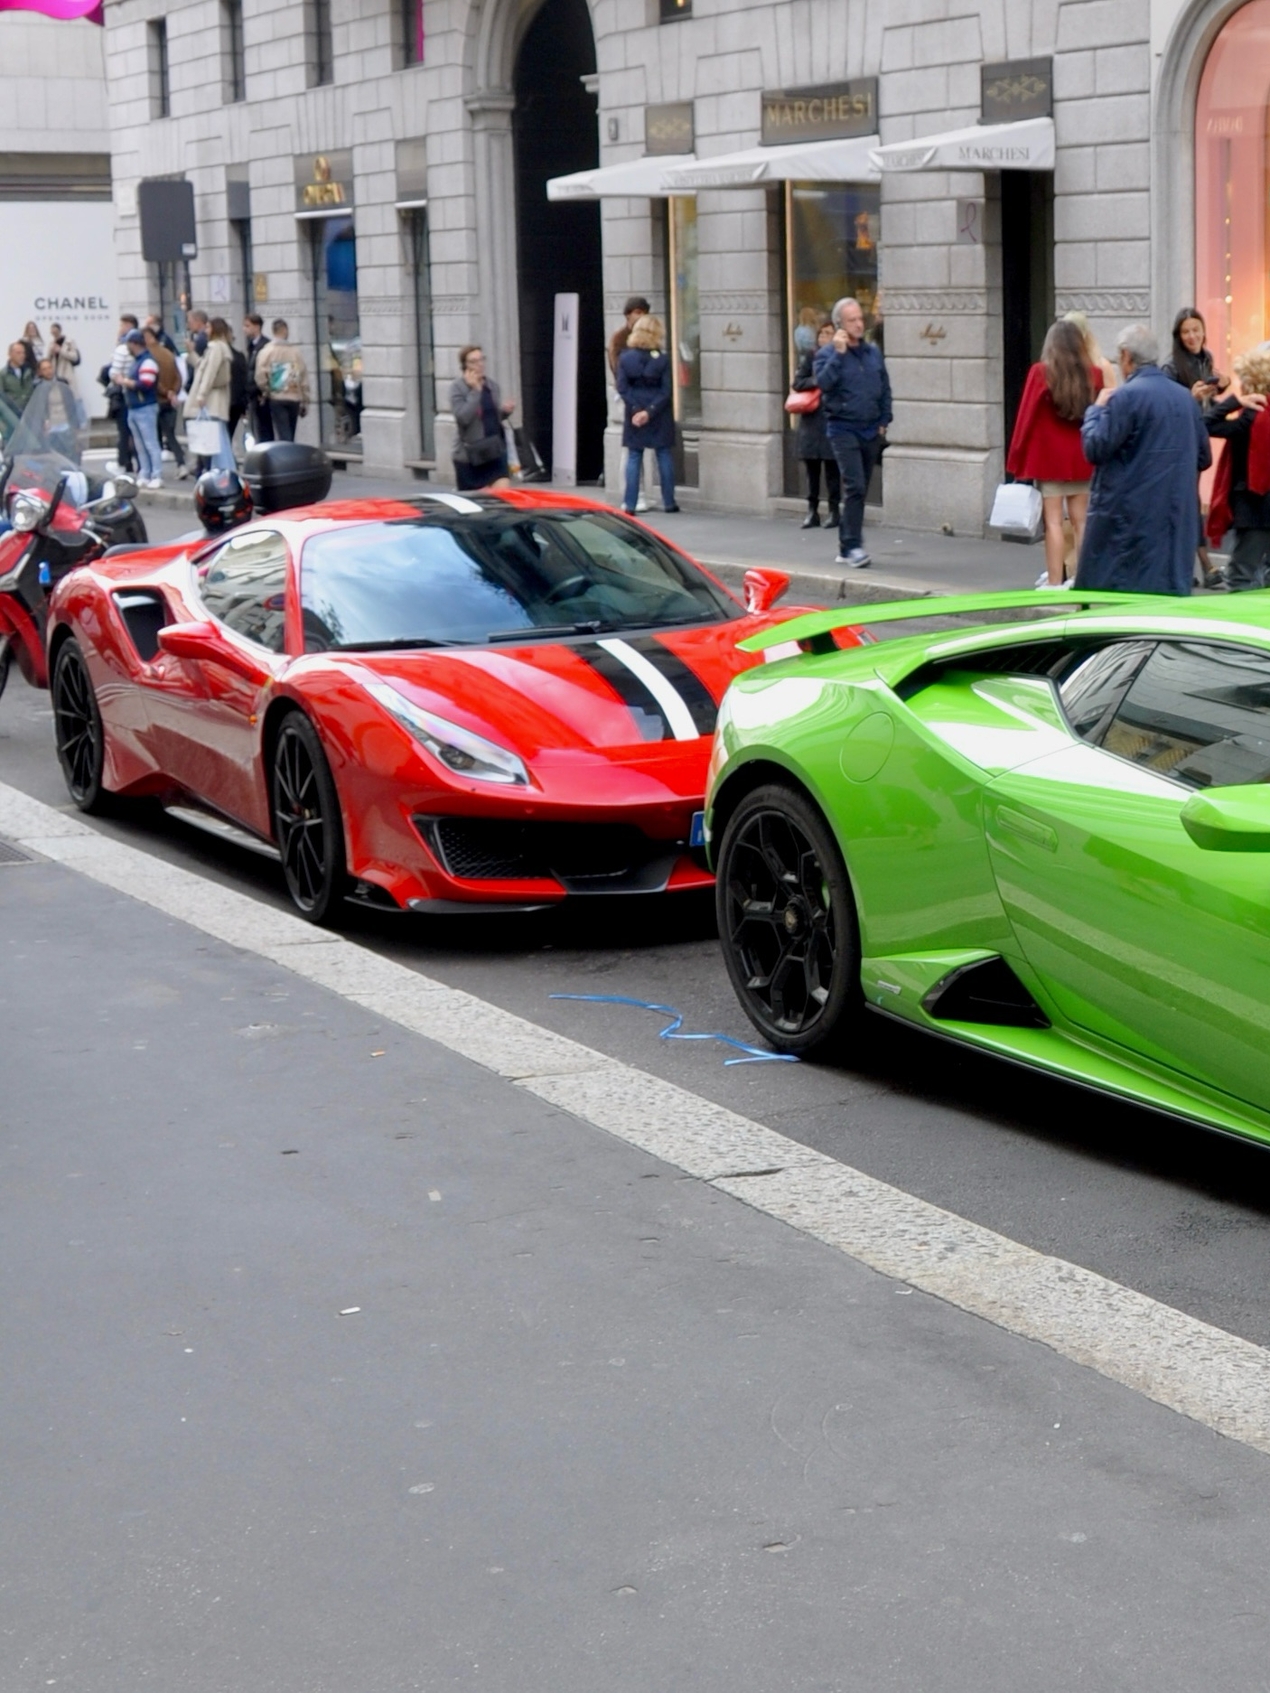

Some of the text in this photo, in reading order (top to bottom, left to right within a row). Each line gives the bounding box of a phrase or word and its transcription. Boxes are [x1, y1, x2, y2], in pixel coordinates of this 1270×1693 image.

[767, 92, 872, 126] MARCHESI
[959, 147, 1030, 160] MARCHESI
[34, 297, 108, 310] CHANEL
